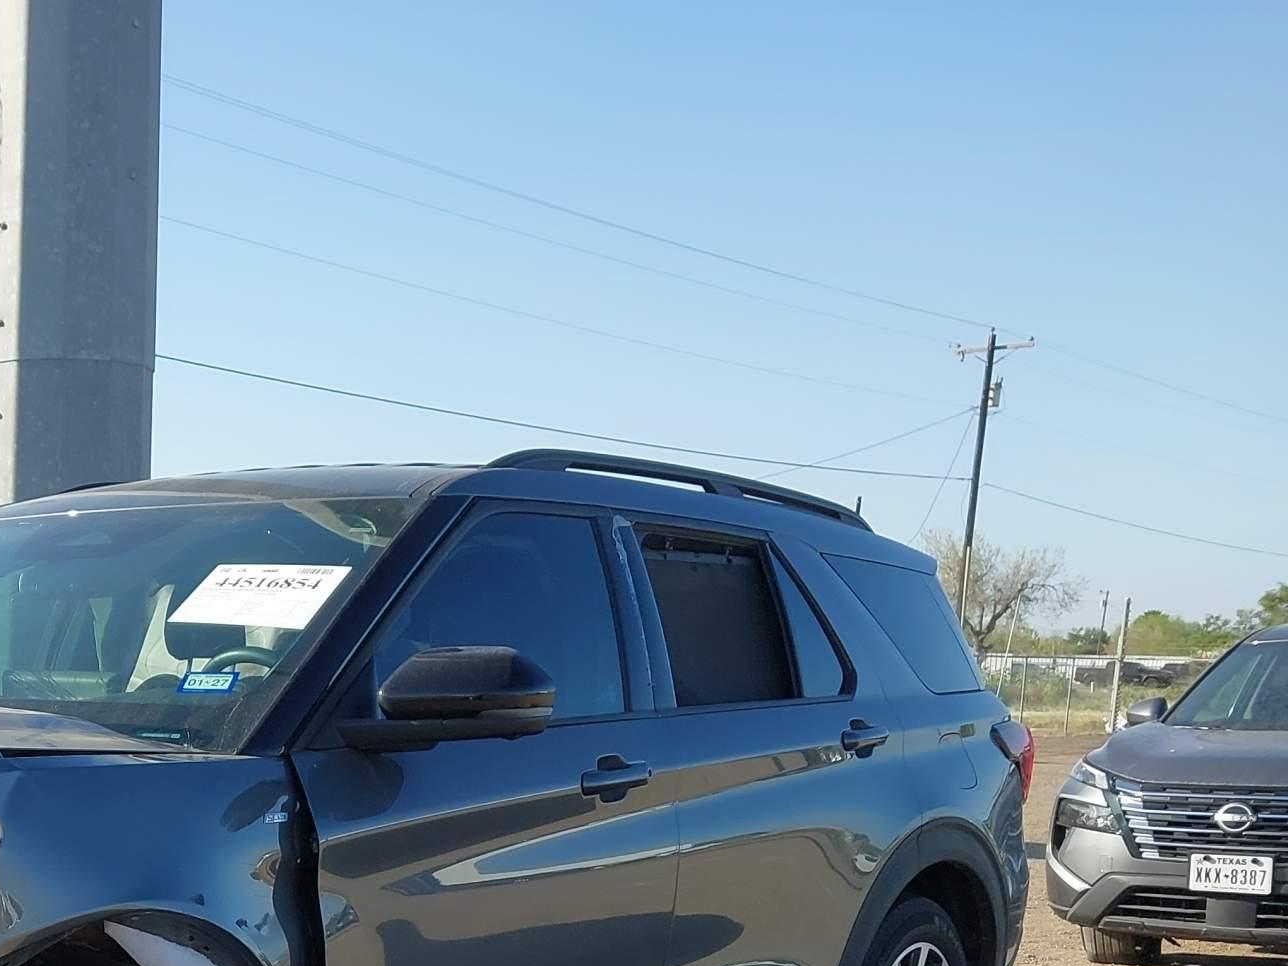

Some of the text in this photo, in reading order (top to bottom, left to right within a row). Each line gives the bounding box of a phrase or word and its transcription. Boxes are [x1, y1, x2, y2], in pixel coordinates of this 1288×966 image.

[215, 577, 323, 590] 44516854
[188, 678, 229, 687] 01 27
[1216, 857, 1247, 866] TEXAS
